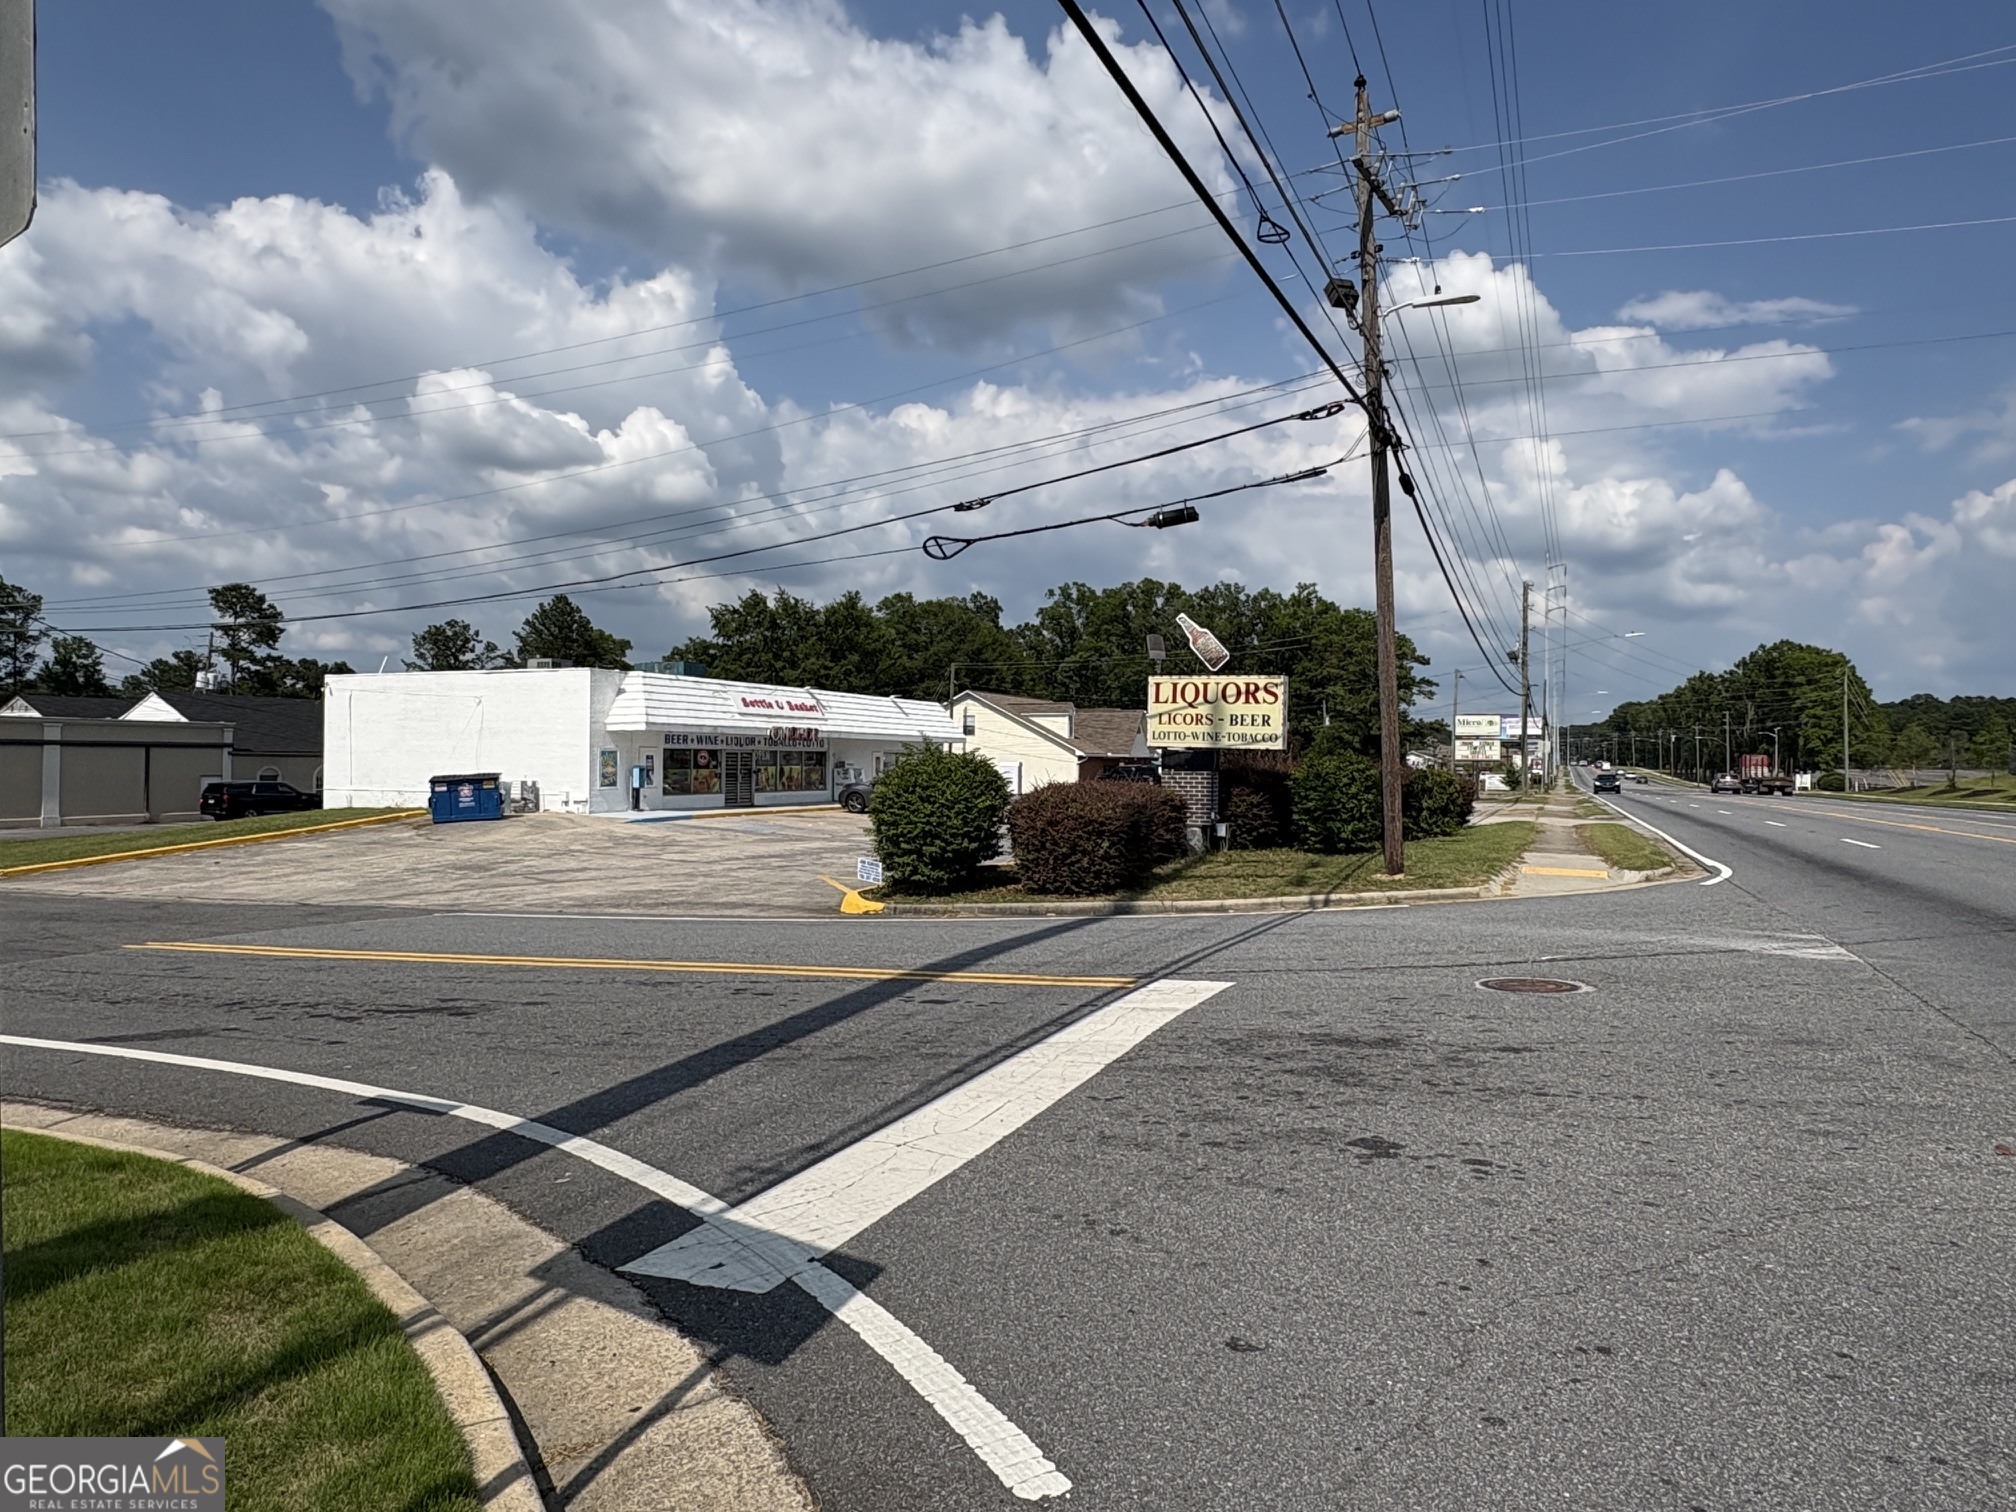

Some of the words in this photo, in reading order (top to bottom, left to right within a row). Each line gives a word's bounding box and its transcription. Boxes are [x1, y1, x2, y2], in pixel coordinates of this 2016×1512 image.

[1152, 681, 1279, 709] LIQUORS
[1158, 712, 1214, 726] LICORS
[1229, 714, 1272, 727] BEER
[664, 733, 689, 745] BEER
[696, 734, 719, 746] WINE
[725, 735, 756, 747] LIQUOR
